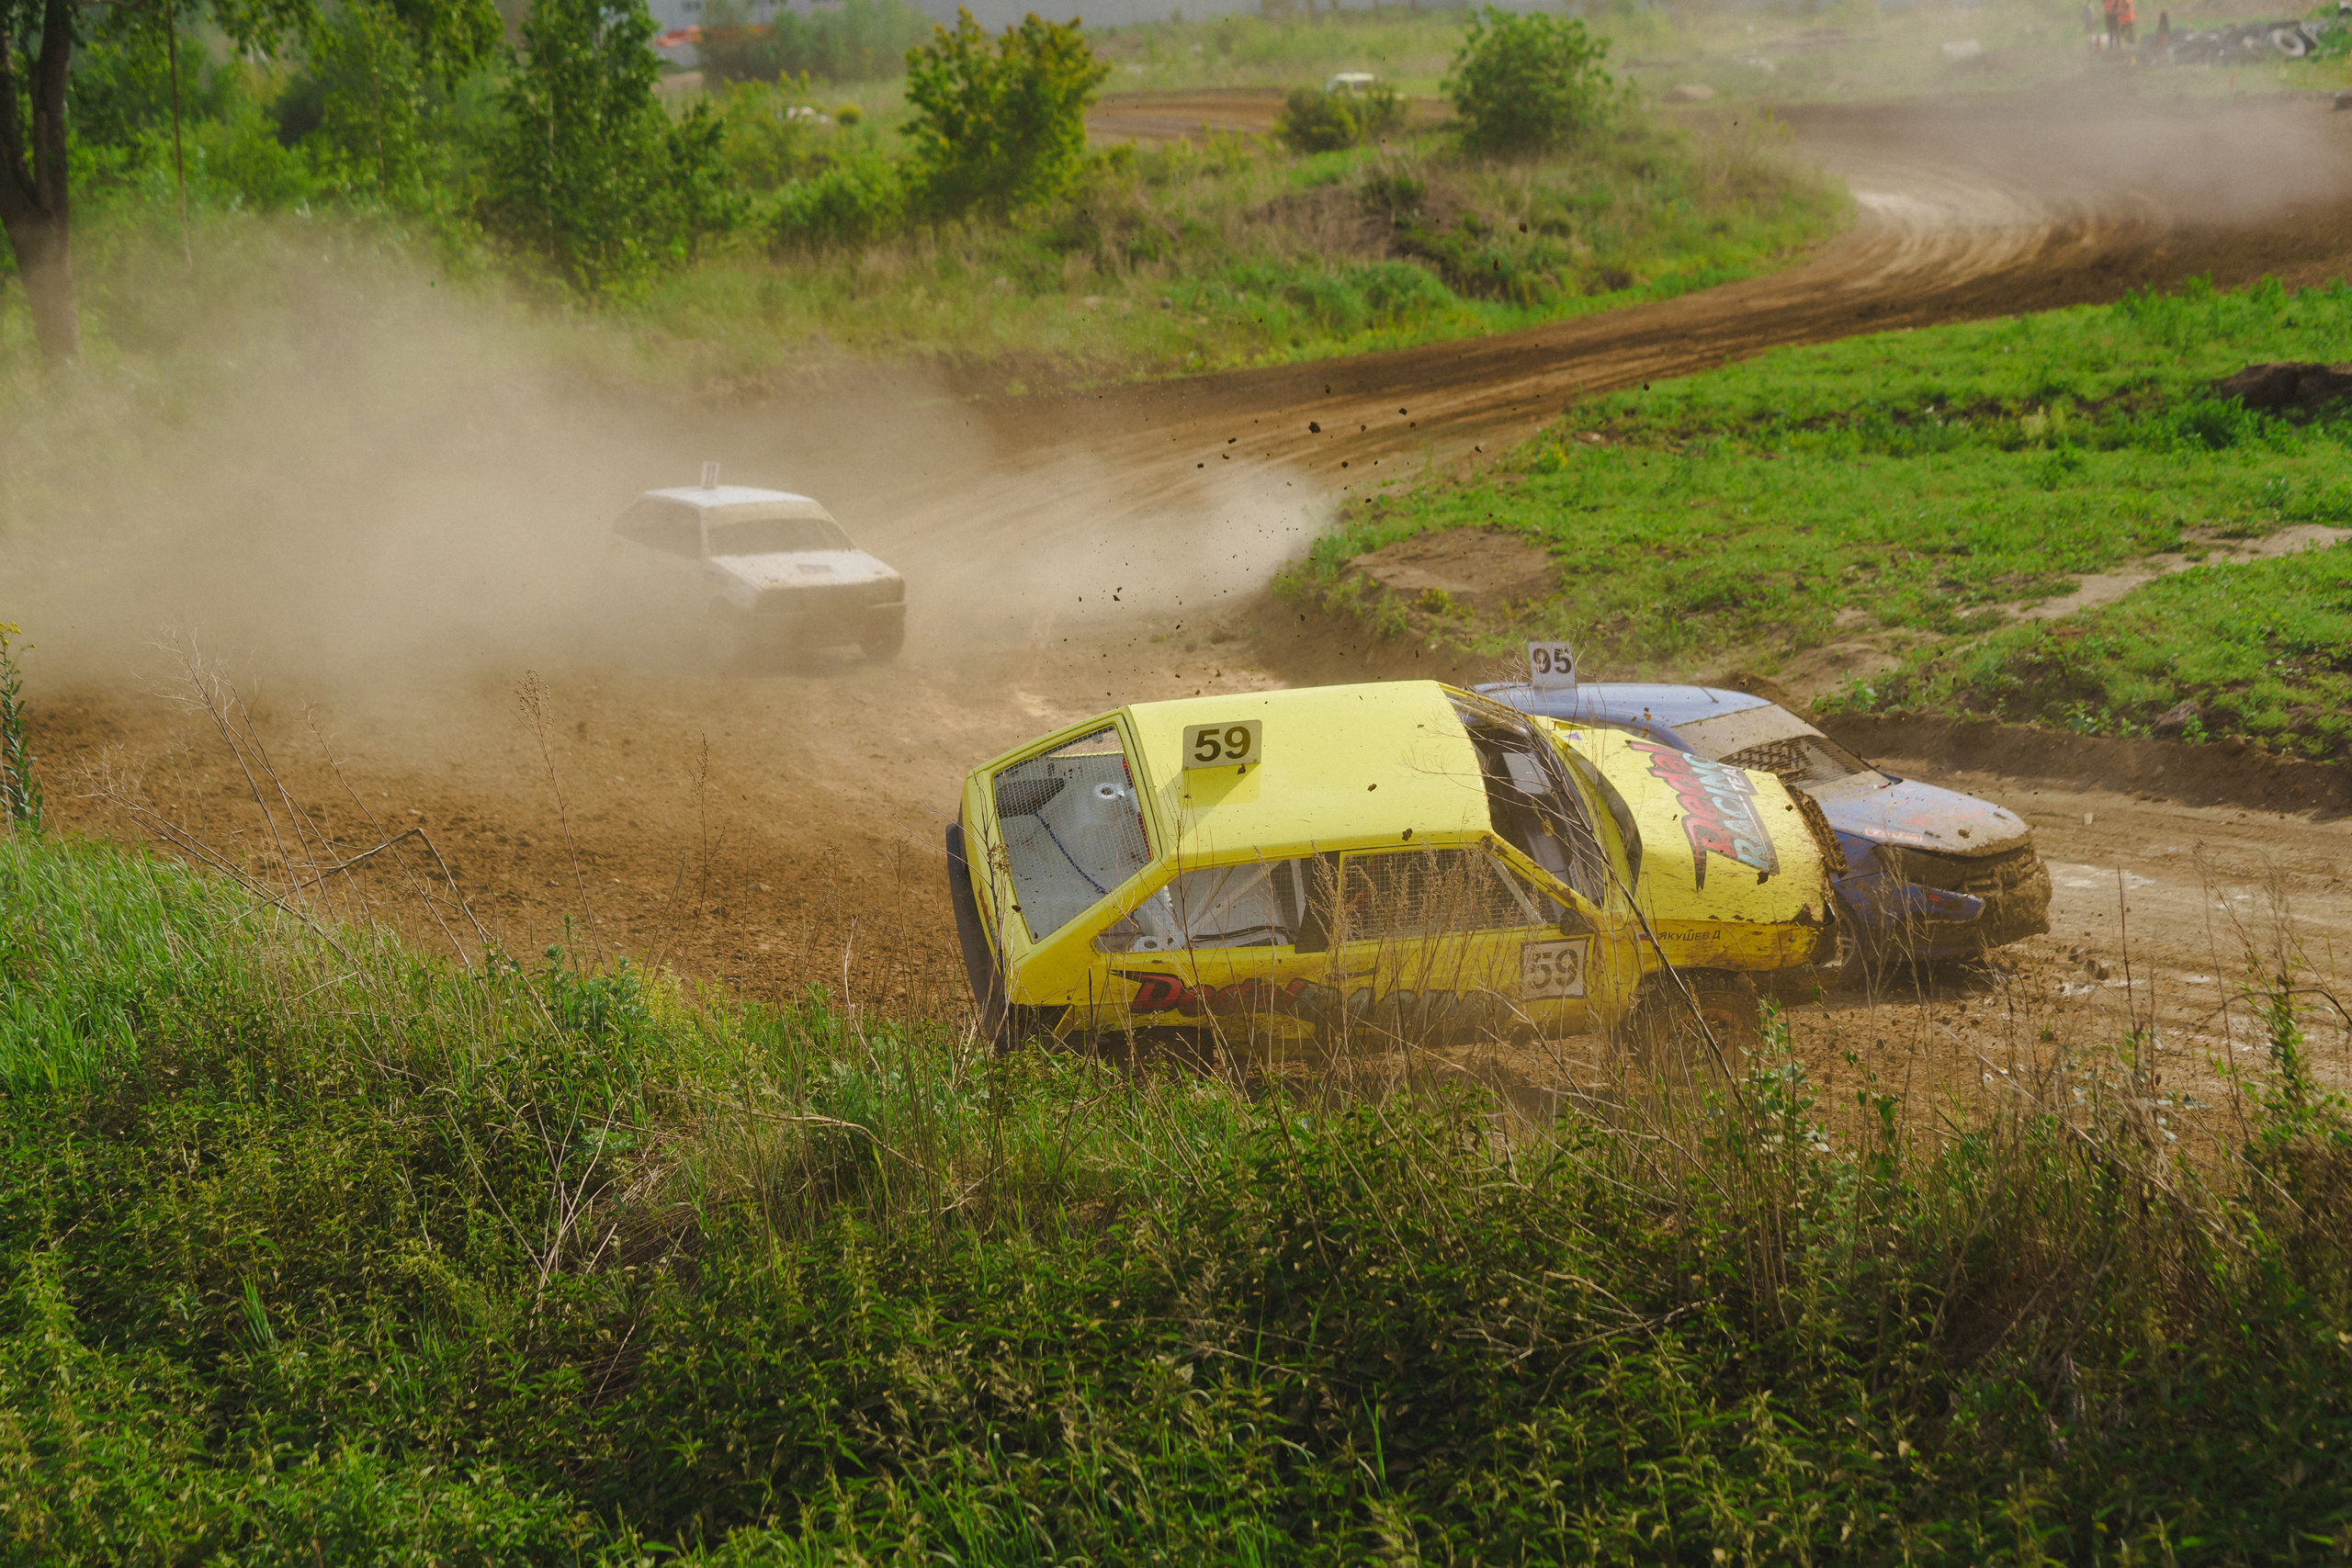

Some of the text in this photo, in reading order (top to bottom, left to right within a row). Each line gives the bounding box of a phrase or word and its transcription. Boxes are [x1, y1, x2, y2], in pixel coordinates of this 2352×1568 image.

[1533, 648, 1572, 674] 95
[1194, 726, 1251, 761] 59
[1629, 741, 1738, 867] Dedal
[1658, 930, 1721, 942] ЯКУШЕВ Д
[1530, 948, 1578, 989] 59
